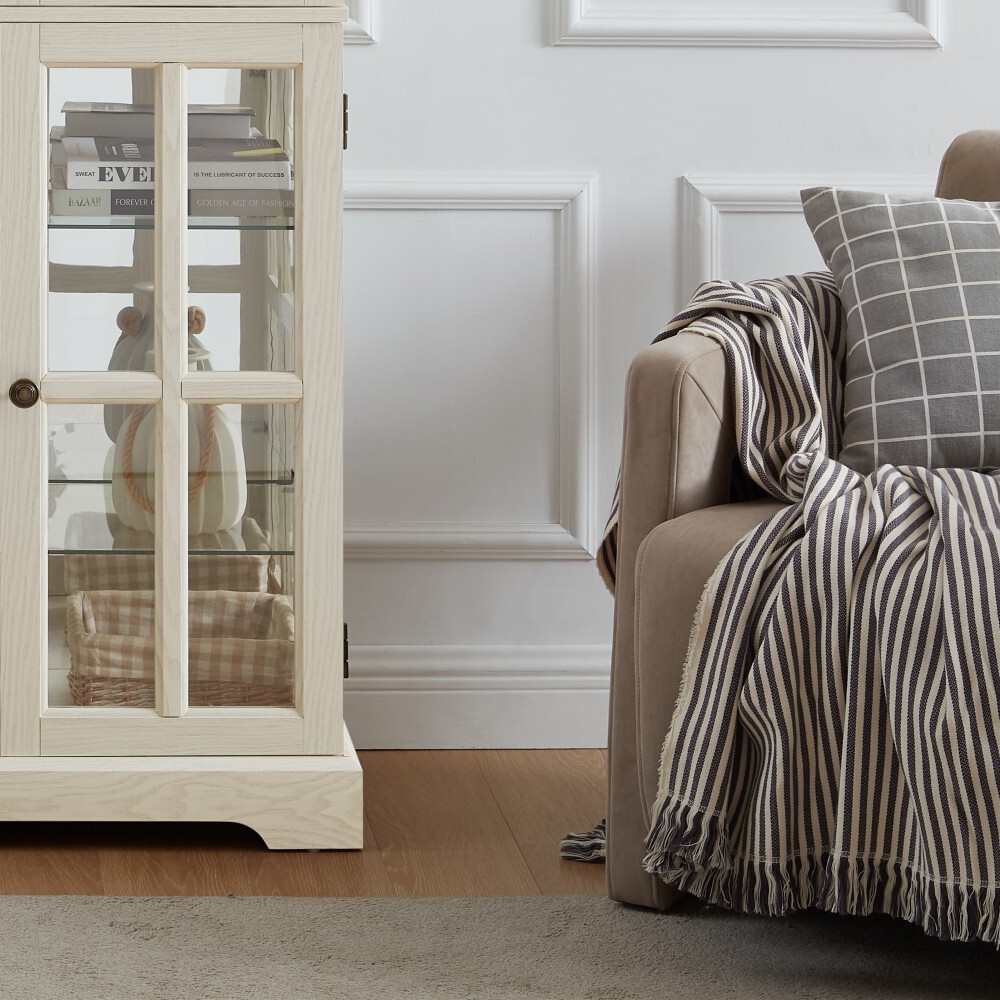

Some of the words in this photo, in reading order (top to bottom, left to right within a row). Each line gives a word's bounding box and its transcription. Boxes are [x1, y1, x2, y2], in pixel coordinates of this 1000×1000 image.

[115, 198, 148, 206] FOREVER
[196, 199, 228, 207] GOLDEN
[231, 199, 246, 207] AGE
[248, 199, 259, 207] OF
